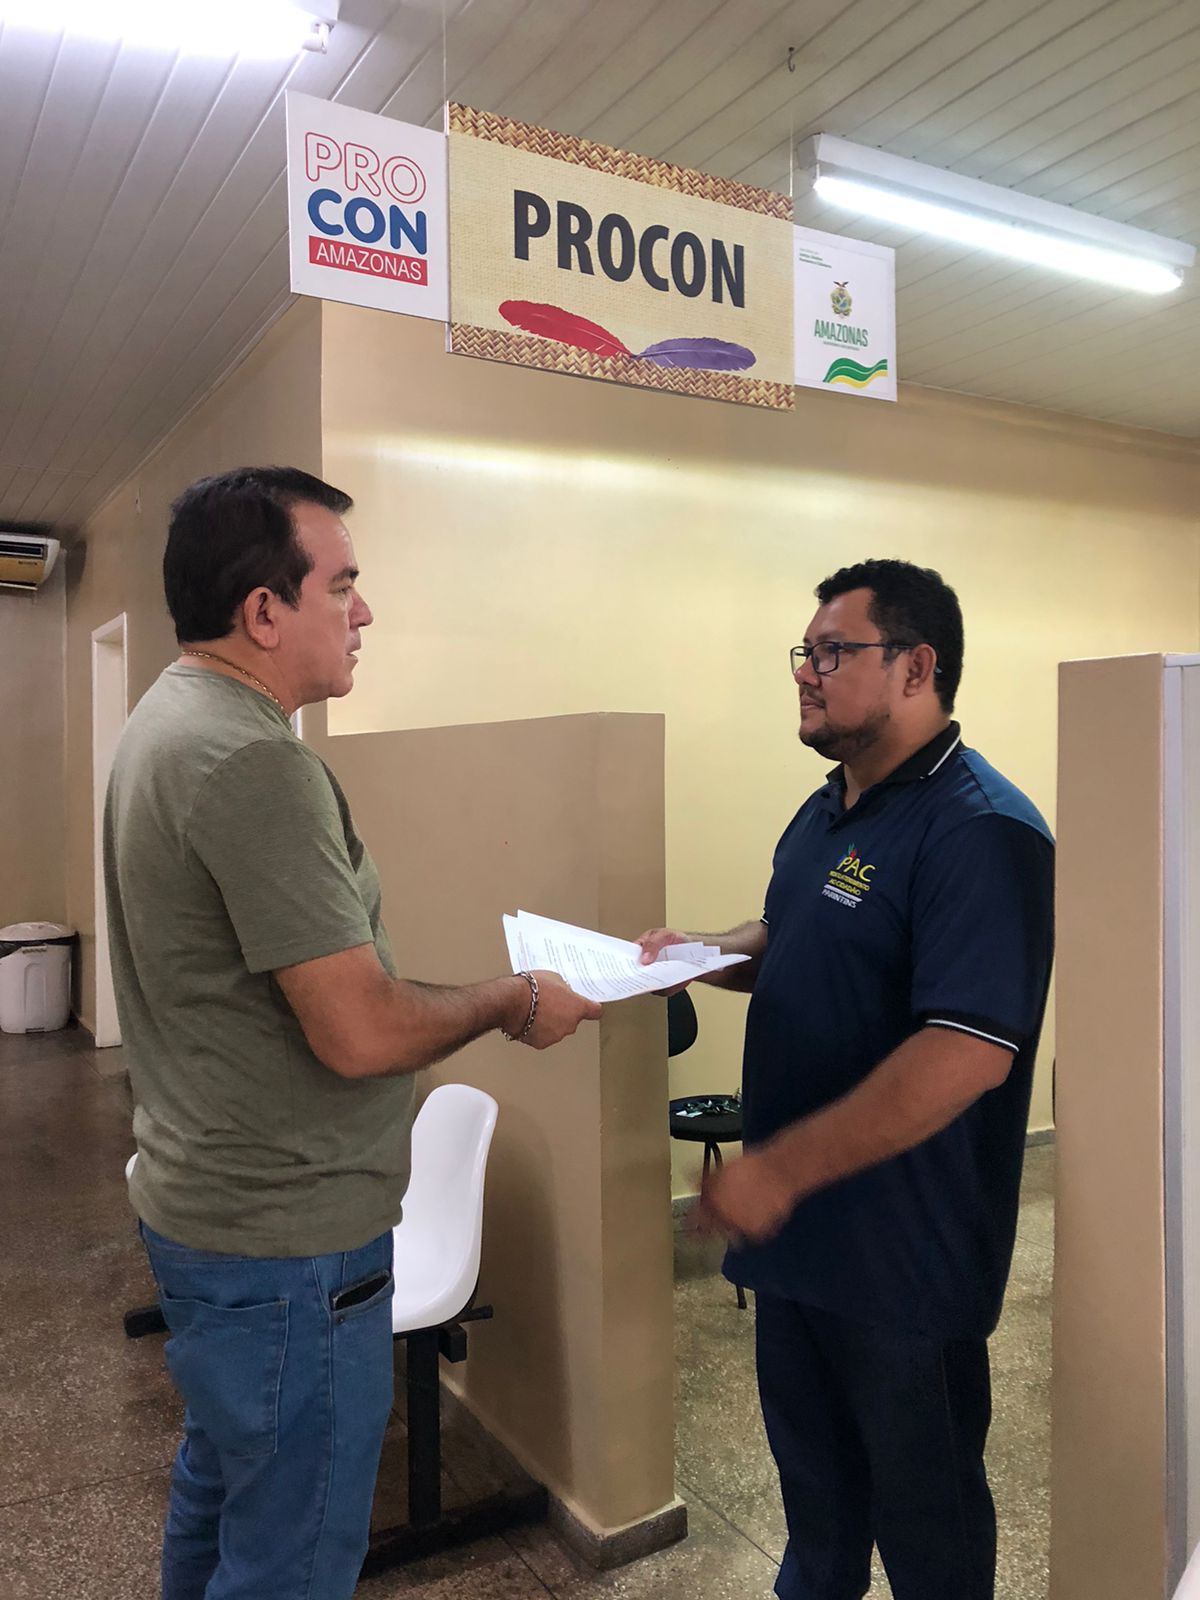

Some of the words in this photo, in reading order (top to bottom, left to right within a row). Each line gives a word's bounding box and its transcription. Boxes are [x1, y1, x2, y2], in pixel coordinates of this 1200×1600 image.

[305, 131, 427, 205] PRO
[307, 188, 428, 256] CON
[315, 242, 423, 281] AMAZONAS
[513, 189, 746, 309] PROCON
[814, 319, 869, 348] AMAZONAS
[836, 857, 876, 882] PAC
[821, 889, 857, 909] PARINTINS
